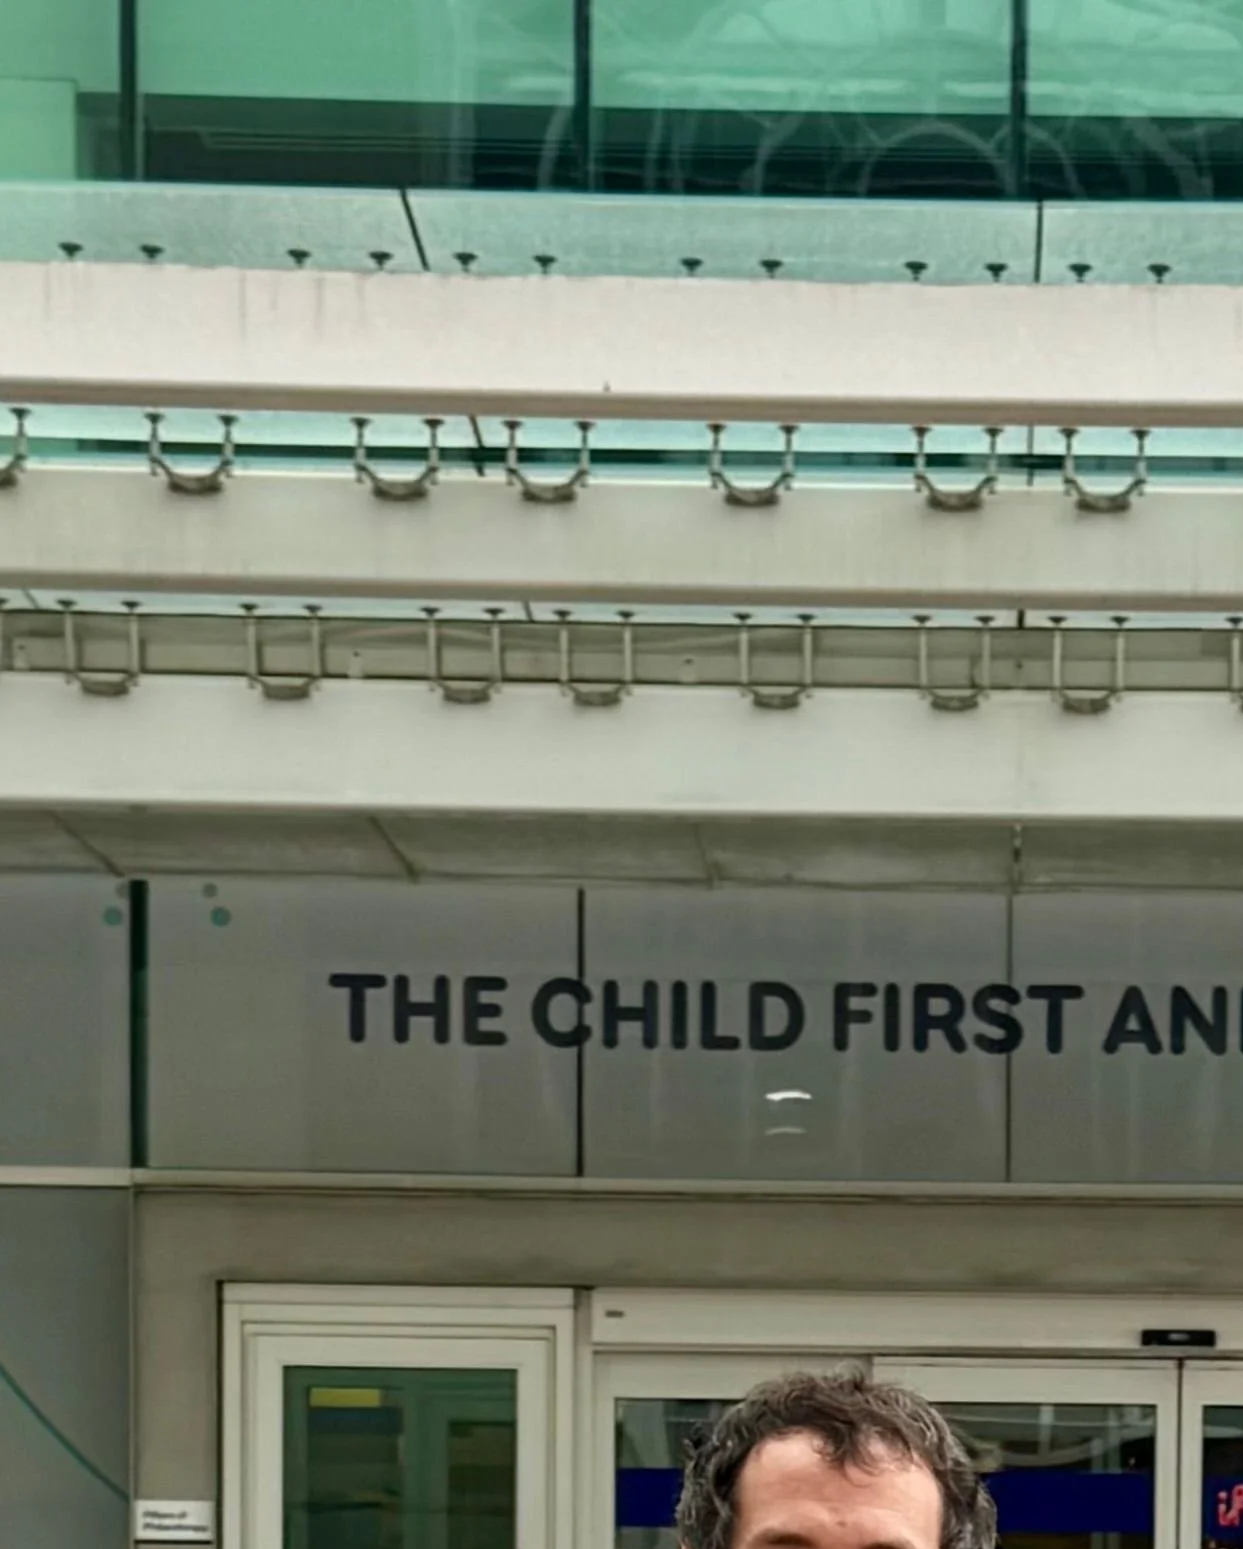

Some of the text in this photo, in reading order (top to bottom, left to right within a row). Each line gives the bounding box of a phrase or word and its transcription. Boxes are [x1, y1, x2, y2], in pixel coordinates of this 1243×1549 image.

[328, 973, 508, 1046] THE
[531, 976, 806, 1052] CHILD
[832, 981, 1085, 1056] FIRST
